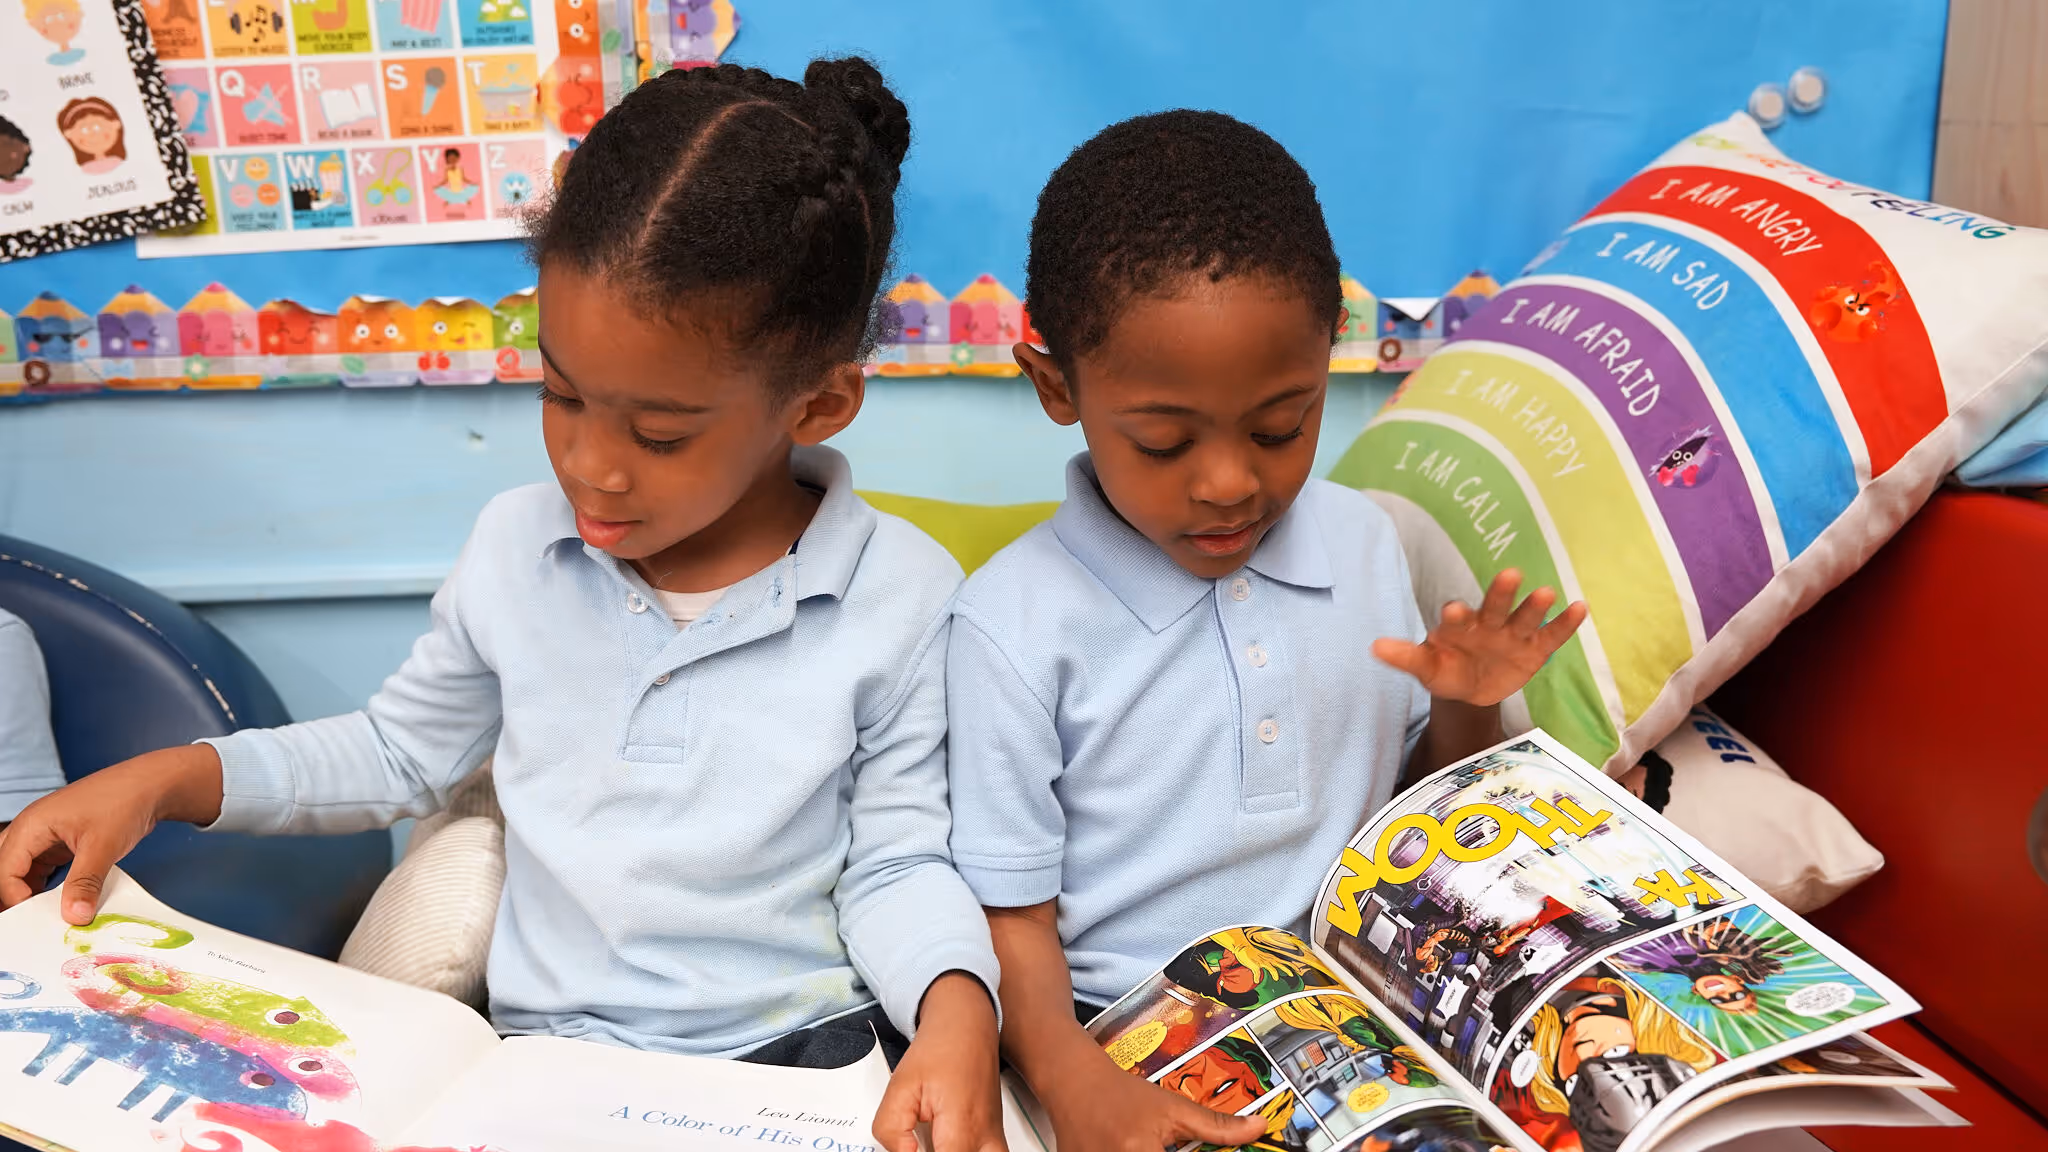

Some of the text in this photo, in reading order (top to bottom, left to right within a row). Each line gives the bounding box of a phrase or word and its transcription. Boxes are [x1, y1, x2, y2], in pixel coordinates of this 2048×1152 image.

[57, 72, 95, 90] BRAVE
[220, 69, 245, 98] Q
[301, 66, 321, 90] R
[386, 64, 408, 90] S
[466, 61, 486, 86] T
[287, 155, 316, 179] W
[355, 152, 376, 176] X
[421, 149, 441, 173] Y
[489, 146, 507, 168] Z
[219, 158, 239, 182] V
[88, 179, 137, 200] JEALOUS
[2, 202, 34, 216] CALM
[1649, 179, 1823, 256] I AM ANGRY
[1596, 232, 1729, 310] I AM SAD
[1500, 298, 1661, 416] I AM AFRAID
[1443, 369, 1586, 477] I AM HAPPY
[1394, 441, 1519, 560] I AM CALM
[1326, 798, 1613, 937] THOOM
[608, 1106, 630, 1119] A
[642, 1110, 713, 1130] Color
[719, 1124, 751, 1136] of
[753, 1128, 803, 1145] His
[756, 1107, 858, 1128] Leo Lionni
